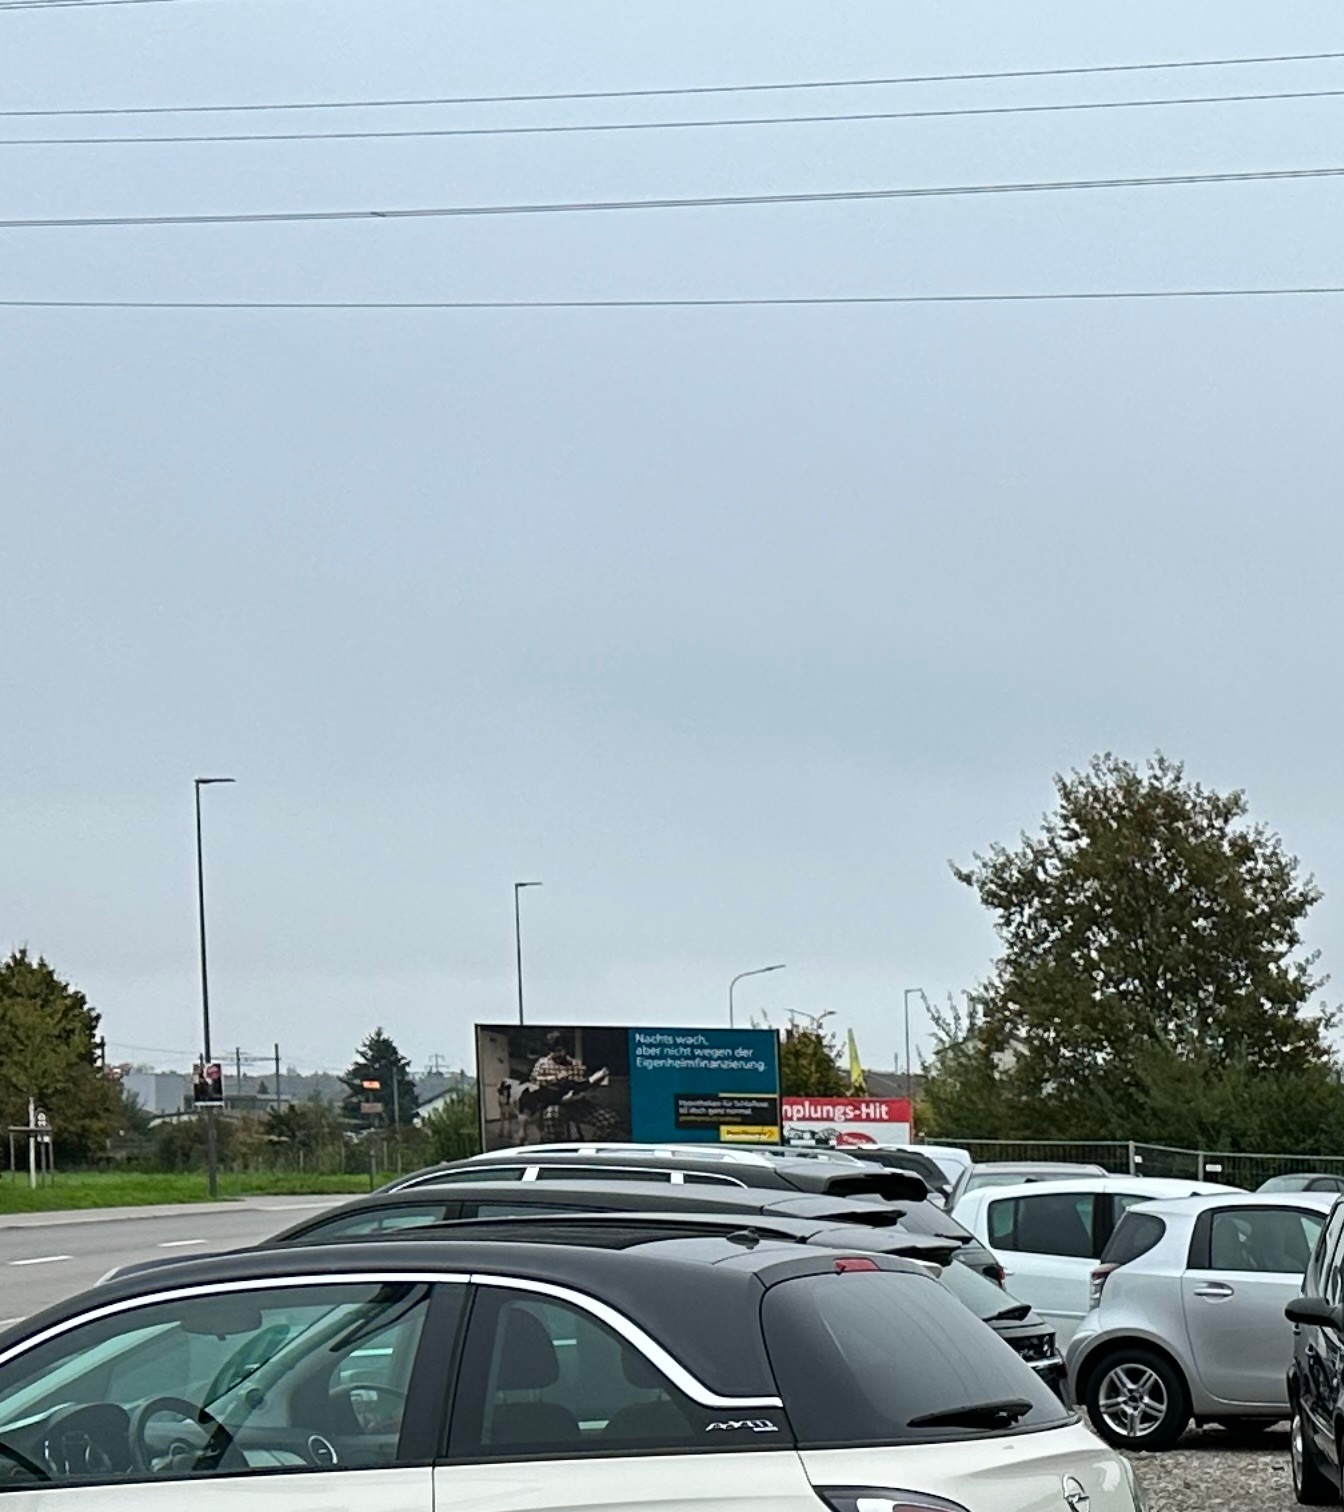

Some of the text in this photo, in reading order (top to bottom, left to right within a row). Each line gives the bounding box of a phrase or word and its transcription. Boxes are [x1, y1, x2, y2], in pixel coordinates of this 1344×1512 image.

[635, 1033, 673, 1044] Nachts
[635, 1045, 753, 1059] aber nicht wegen der
